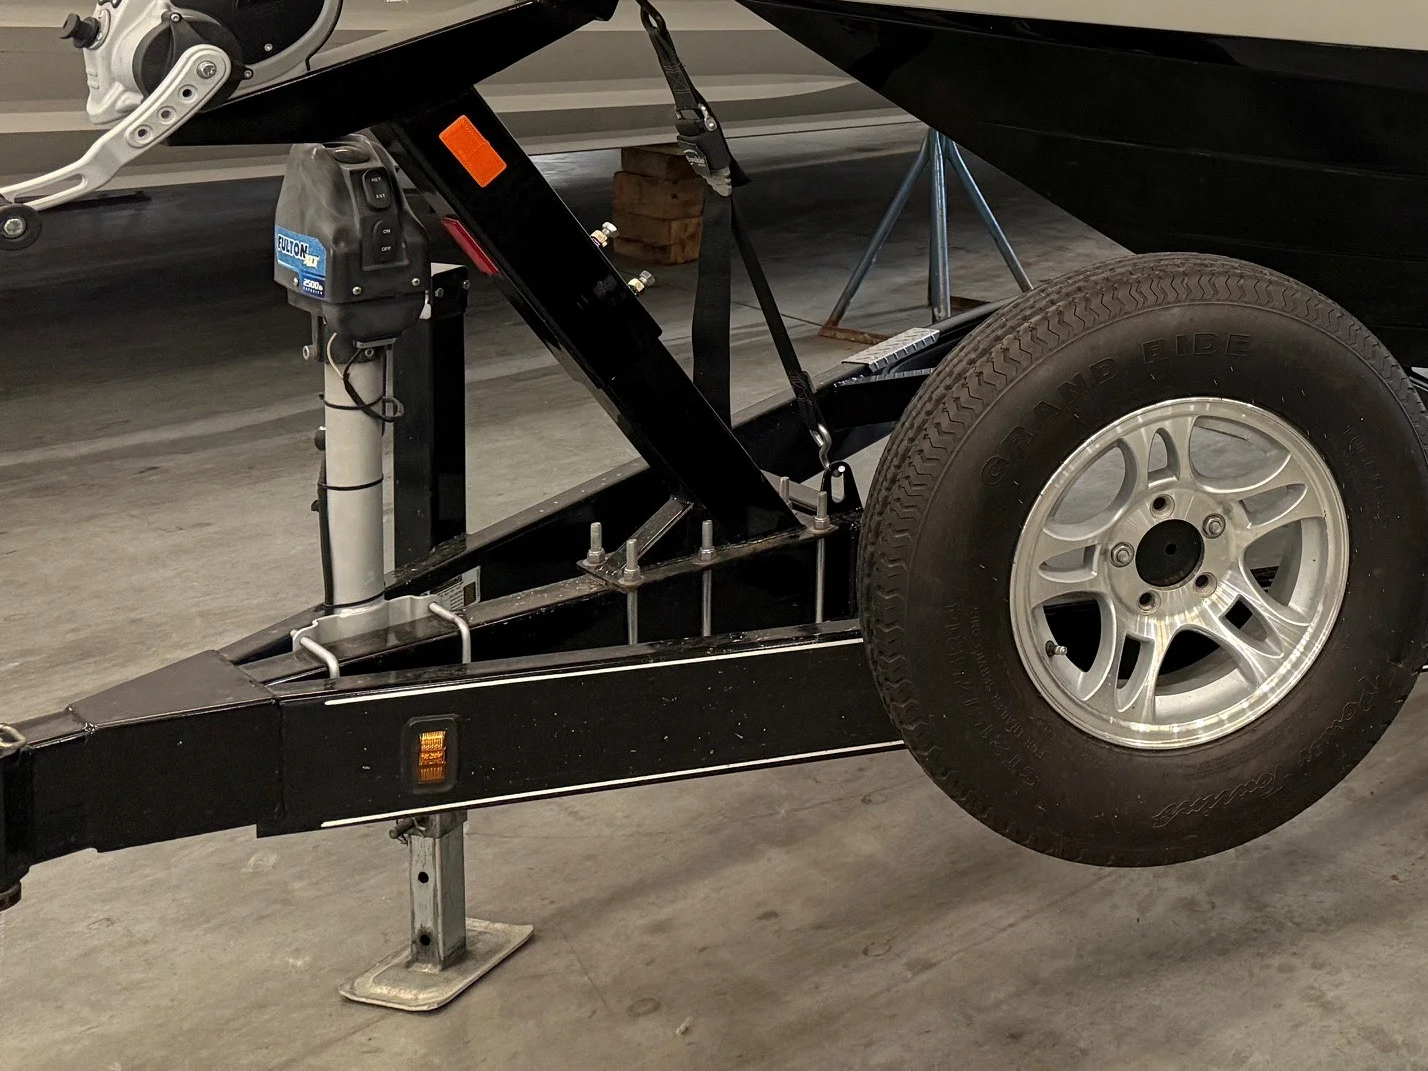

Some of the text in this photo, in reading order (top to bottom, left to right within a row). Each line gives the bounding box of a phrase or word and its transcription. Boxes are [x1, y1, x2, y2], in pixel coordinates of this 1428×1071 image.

[277, 234, 309, 260] FULTON
[981, 333, 1251, 486] GRAND RIDE
